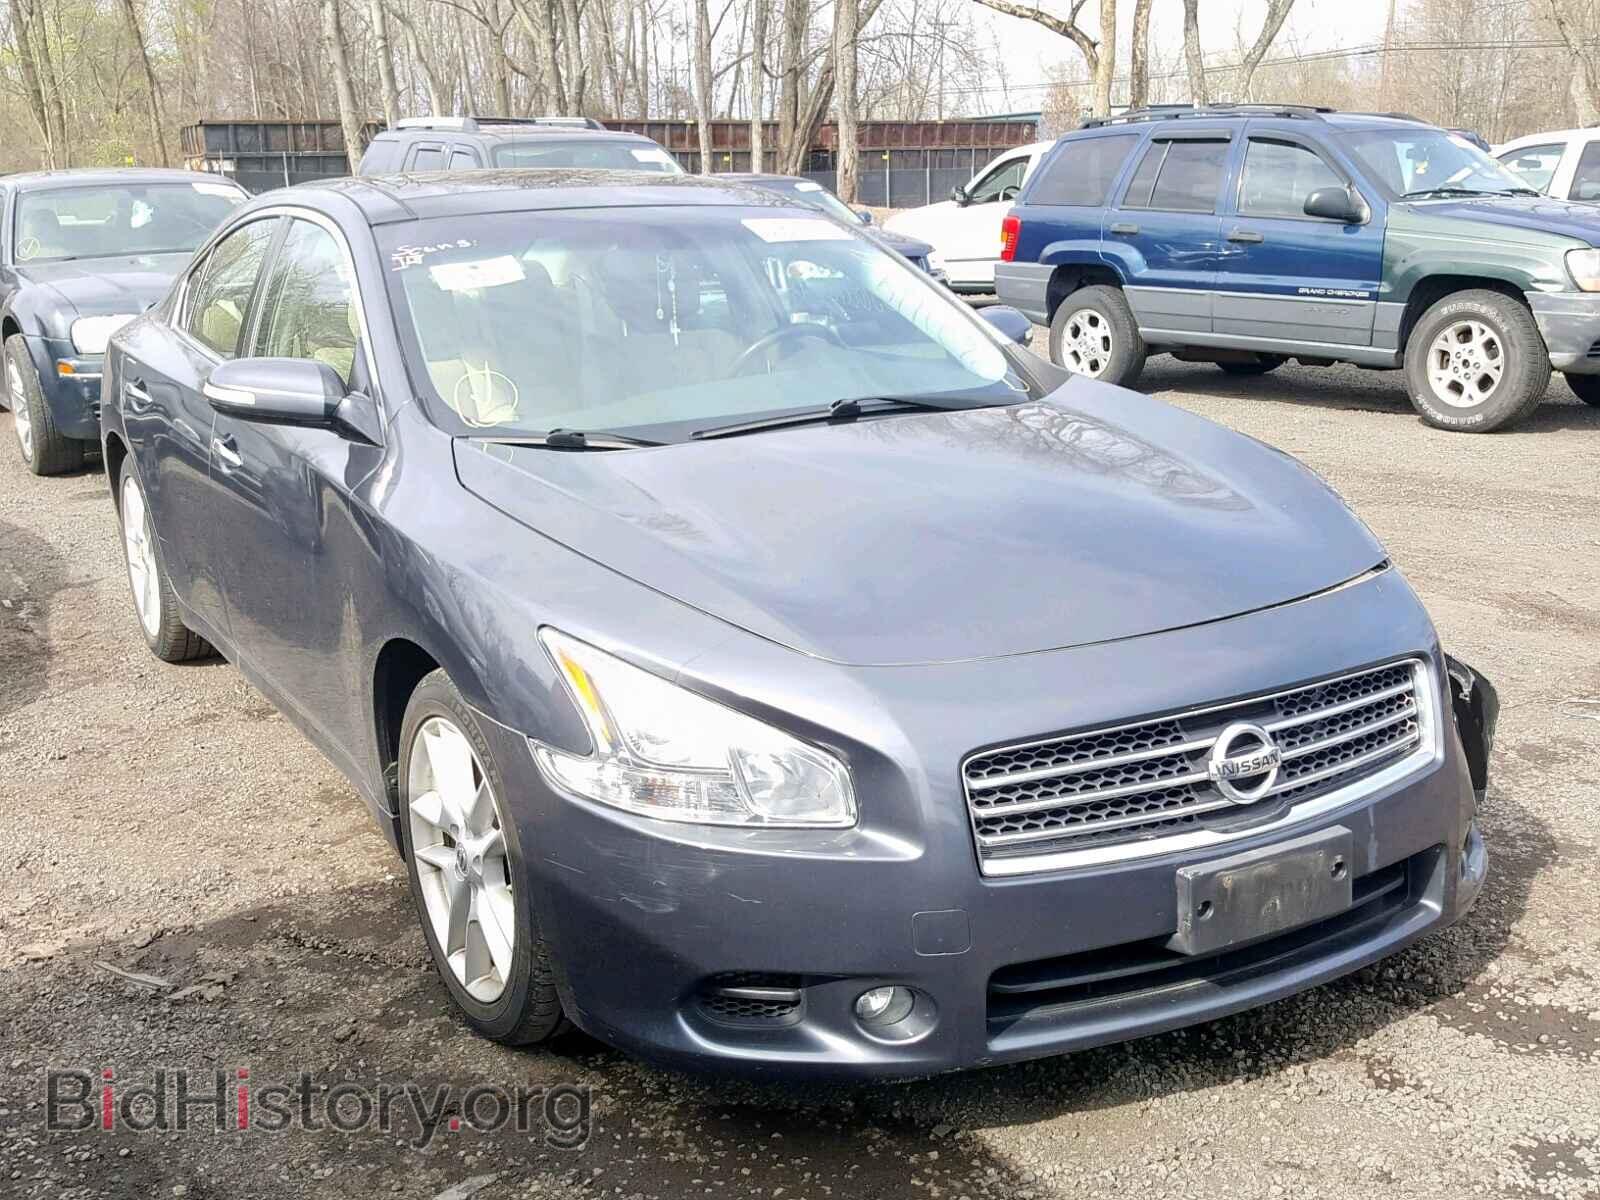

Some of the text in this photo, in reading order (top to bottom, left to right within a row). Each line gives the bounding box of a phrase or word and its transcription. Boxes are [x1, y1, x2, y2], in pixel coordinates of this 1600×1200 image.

[1298, 287, 1370, 297] GRAND CHEROKEE
[1220, 750, 1279, 776] NISSAN
